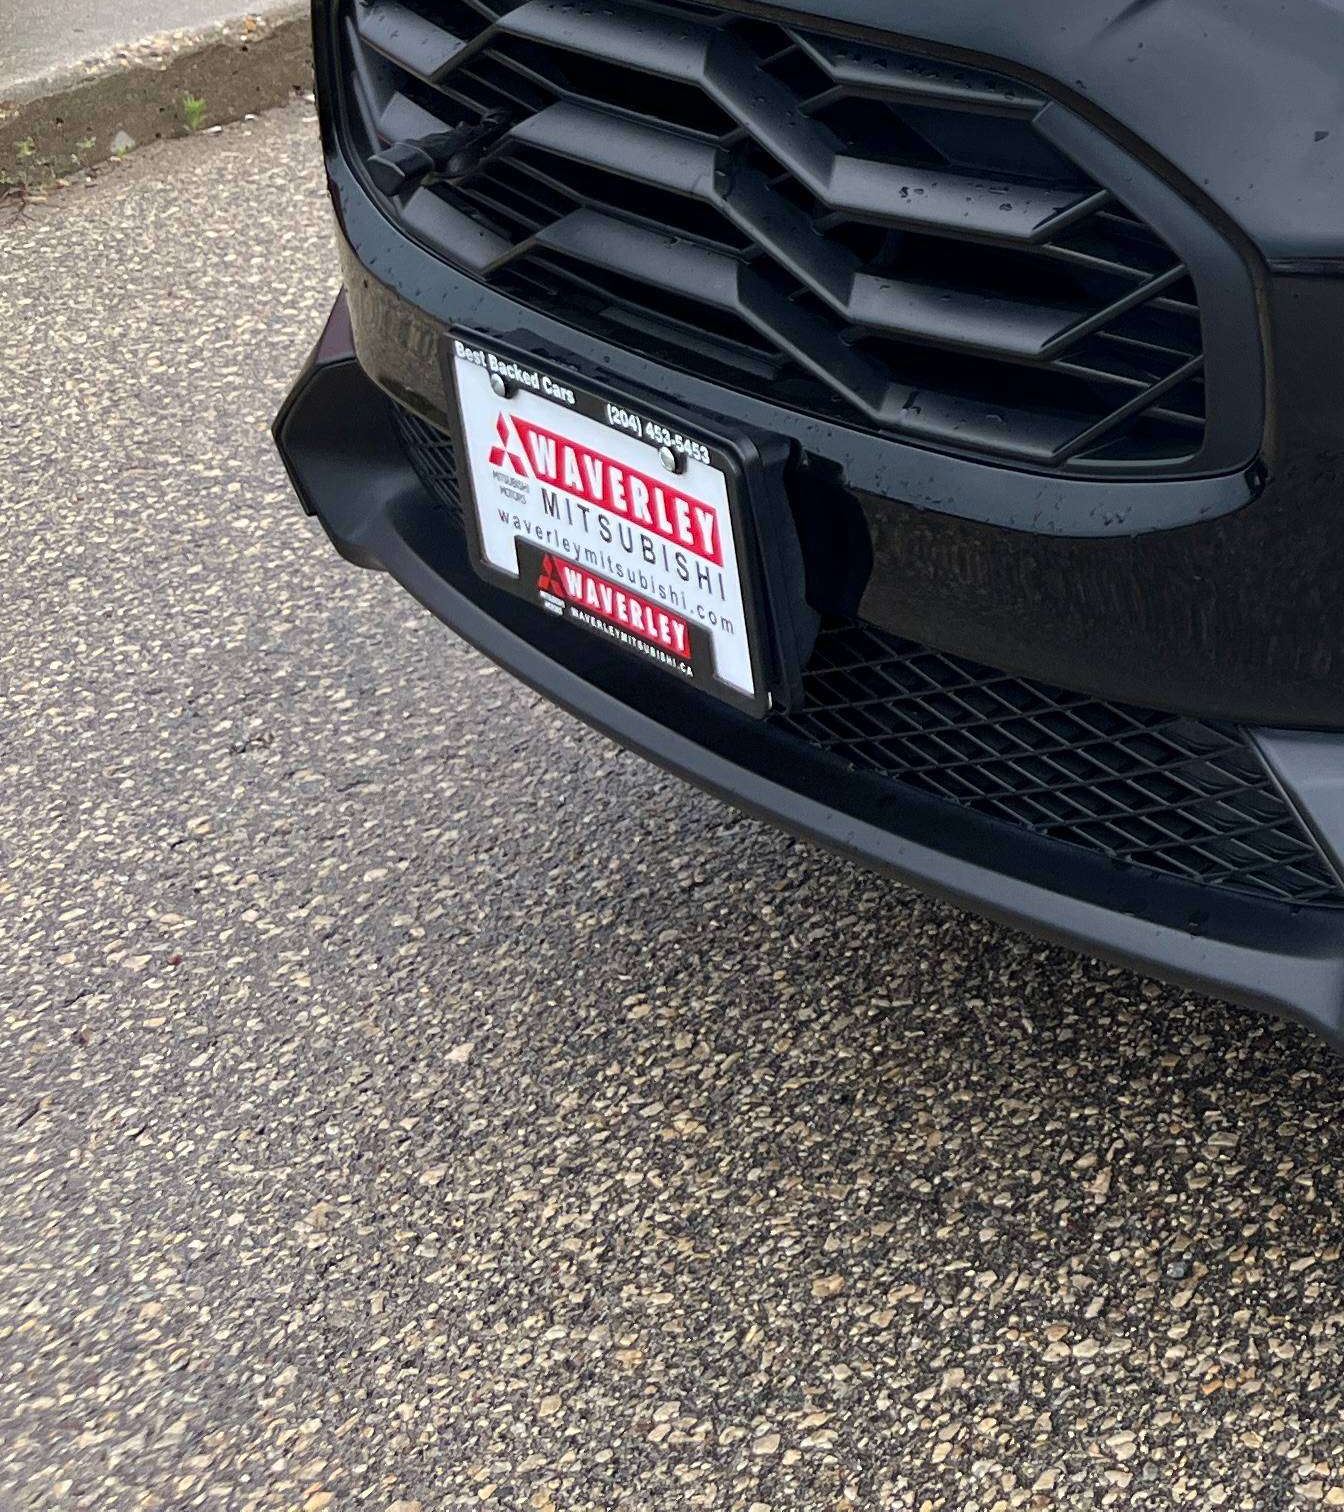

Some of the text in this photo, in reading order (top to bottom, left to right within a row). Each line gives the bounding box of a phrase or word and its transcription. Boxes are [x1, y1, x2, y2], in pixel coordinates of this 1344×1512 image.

[455, 341, 711, 465] Best Backed Cars (204) 453-5453
[528, 431, 716, 555] WAVERLEY
[541, 488, 727, 601] MITSUBISHI
[497, 508, 735, 635] waverleymitsubishi.com
[563, 566, 685, 651] WAVERLEY
